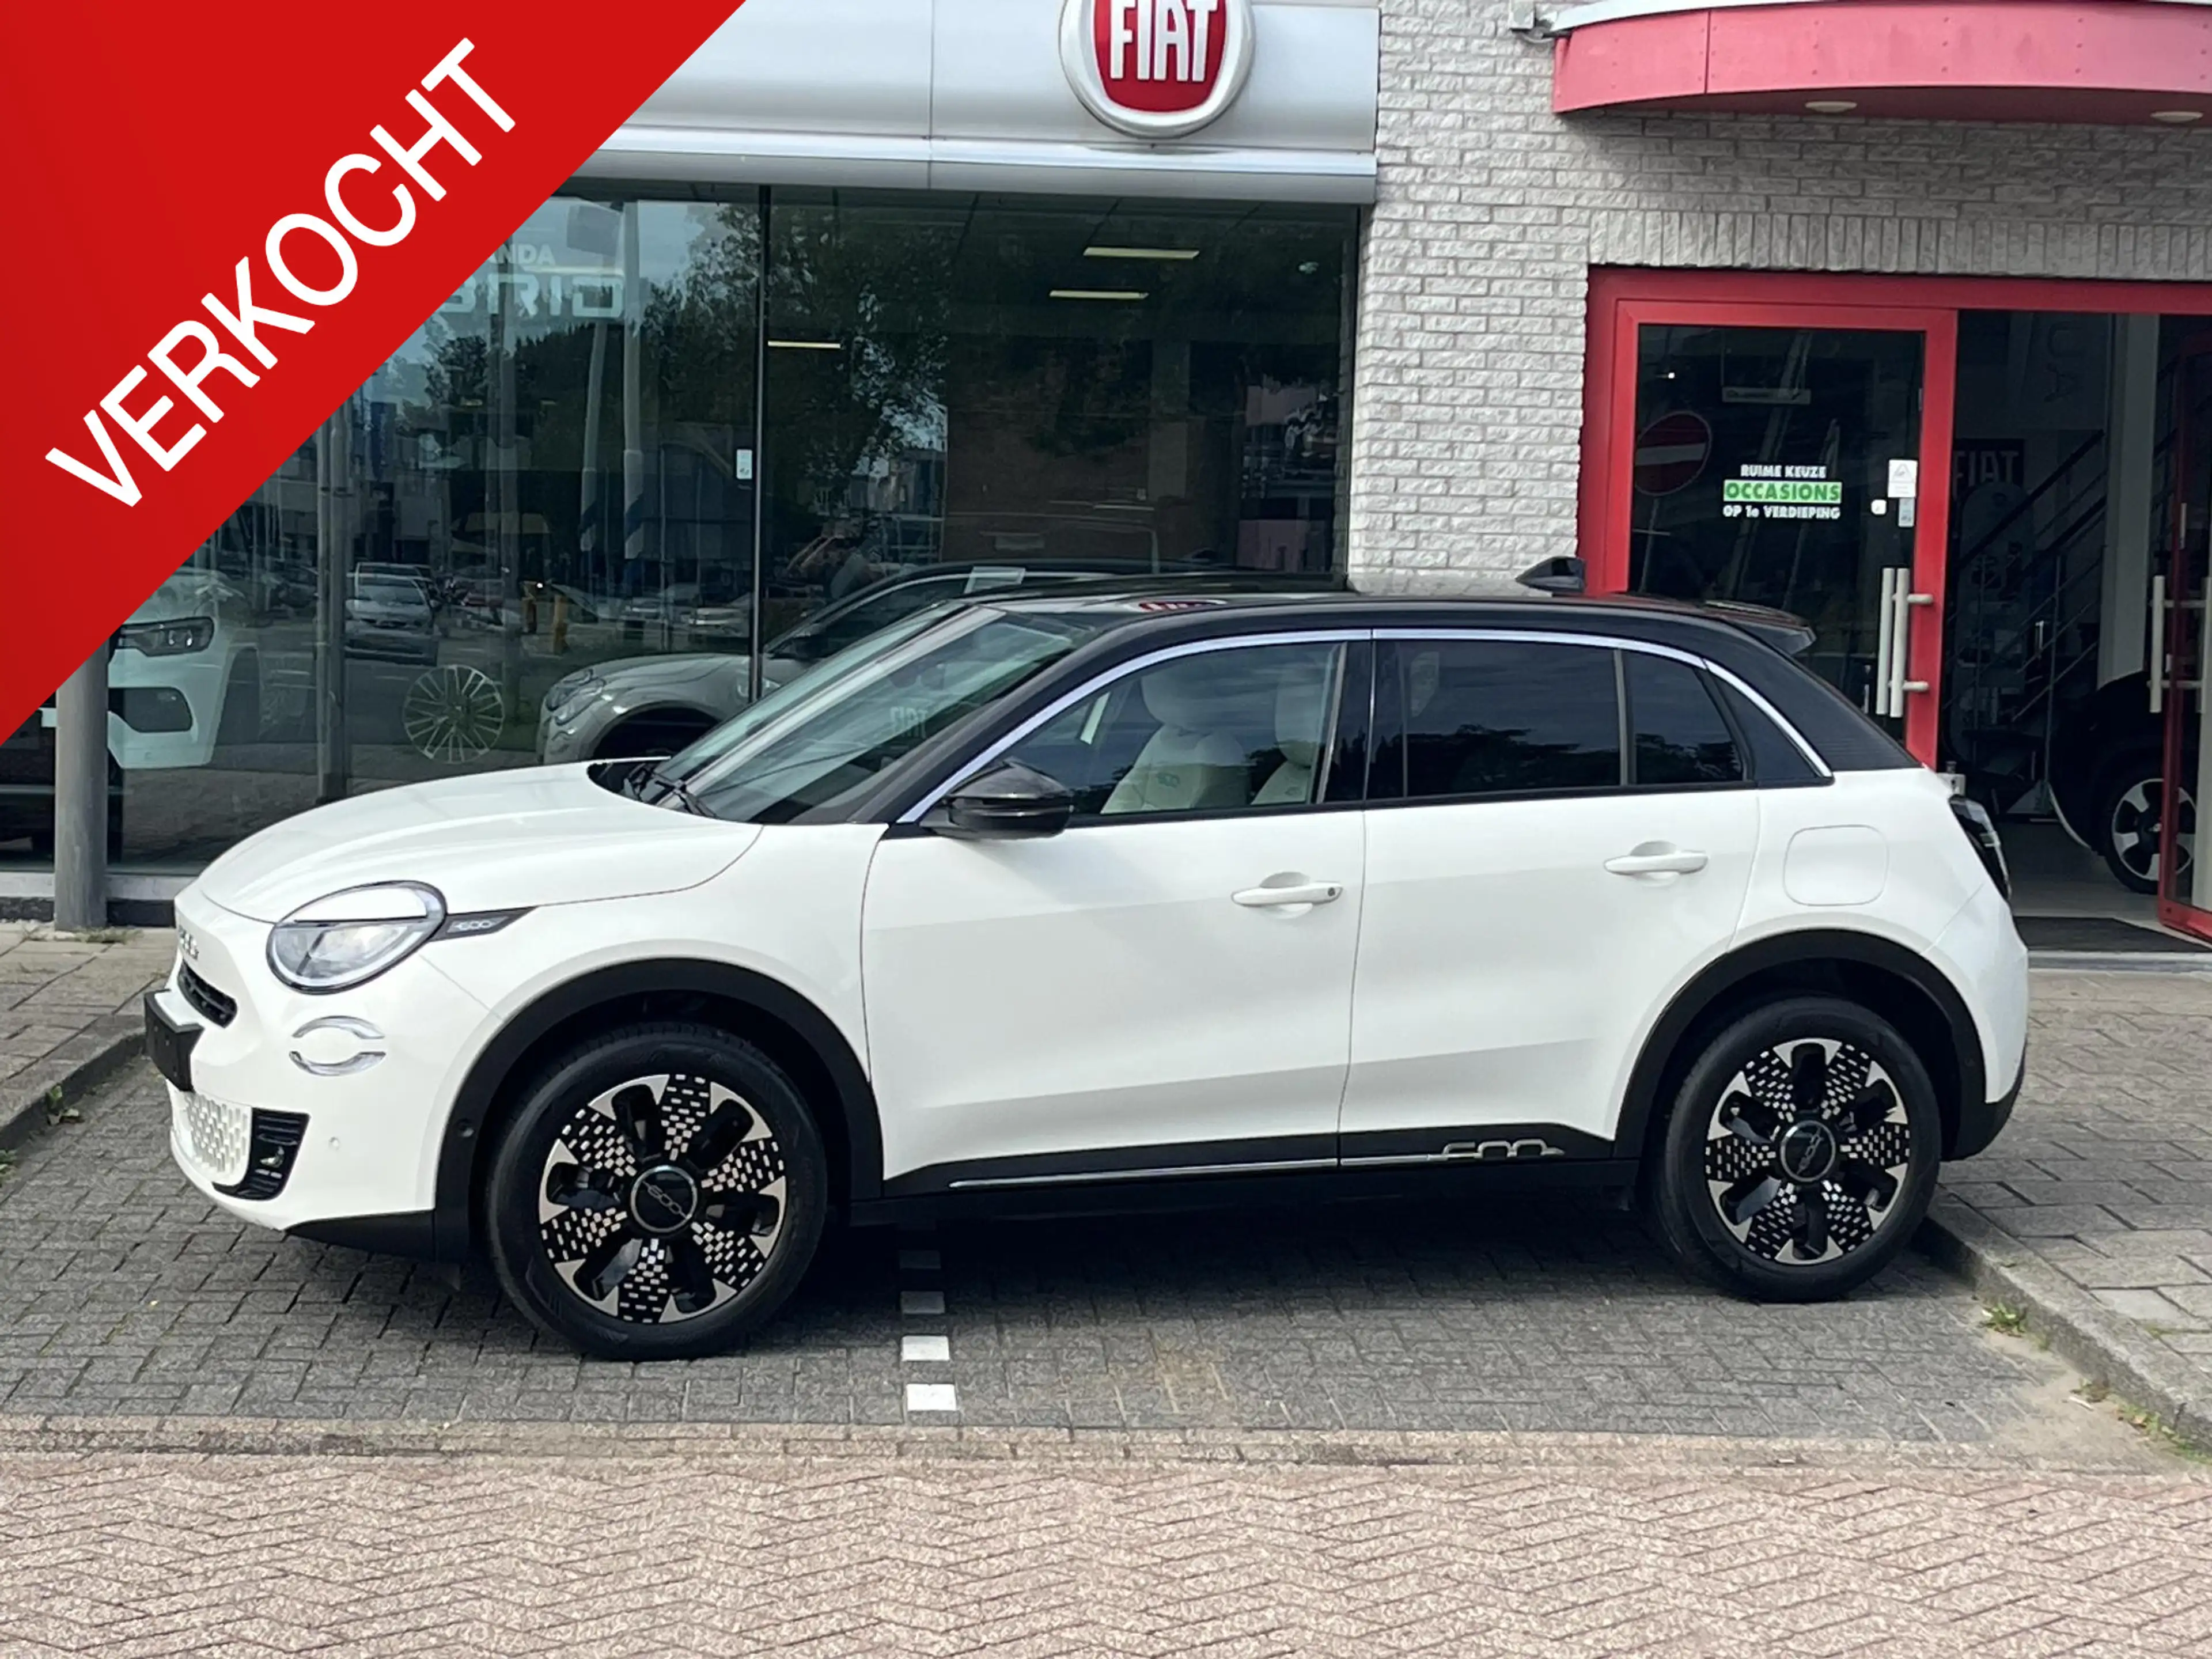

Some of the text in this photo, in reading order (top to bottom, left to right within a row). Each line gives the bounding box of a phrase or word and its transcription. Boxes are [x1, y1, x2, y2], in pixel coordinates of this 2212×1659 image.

[1109, 0, 1218, 82] FIAT
[1740, 464, 1827, 479] RUIME KEUZE
[1952, 450, 2020, 501] FIAT
[1726, 482, 1839, 501] OCCASIONS
[1723, 505, 1743, 517] OP
[1763, 505, 1841, 520] VERDIEPING
[647, 1184, 683, 1215] 600
